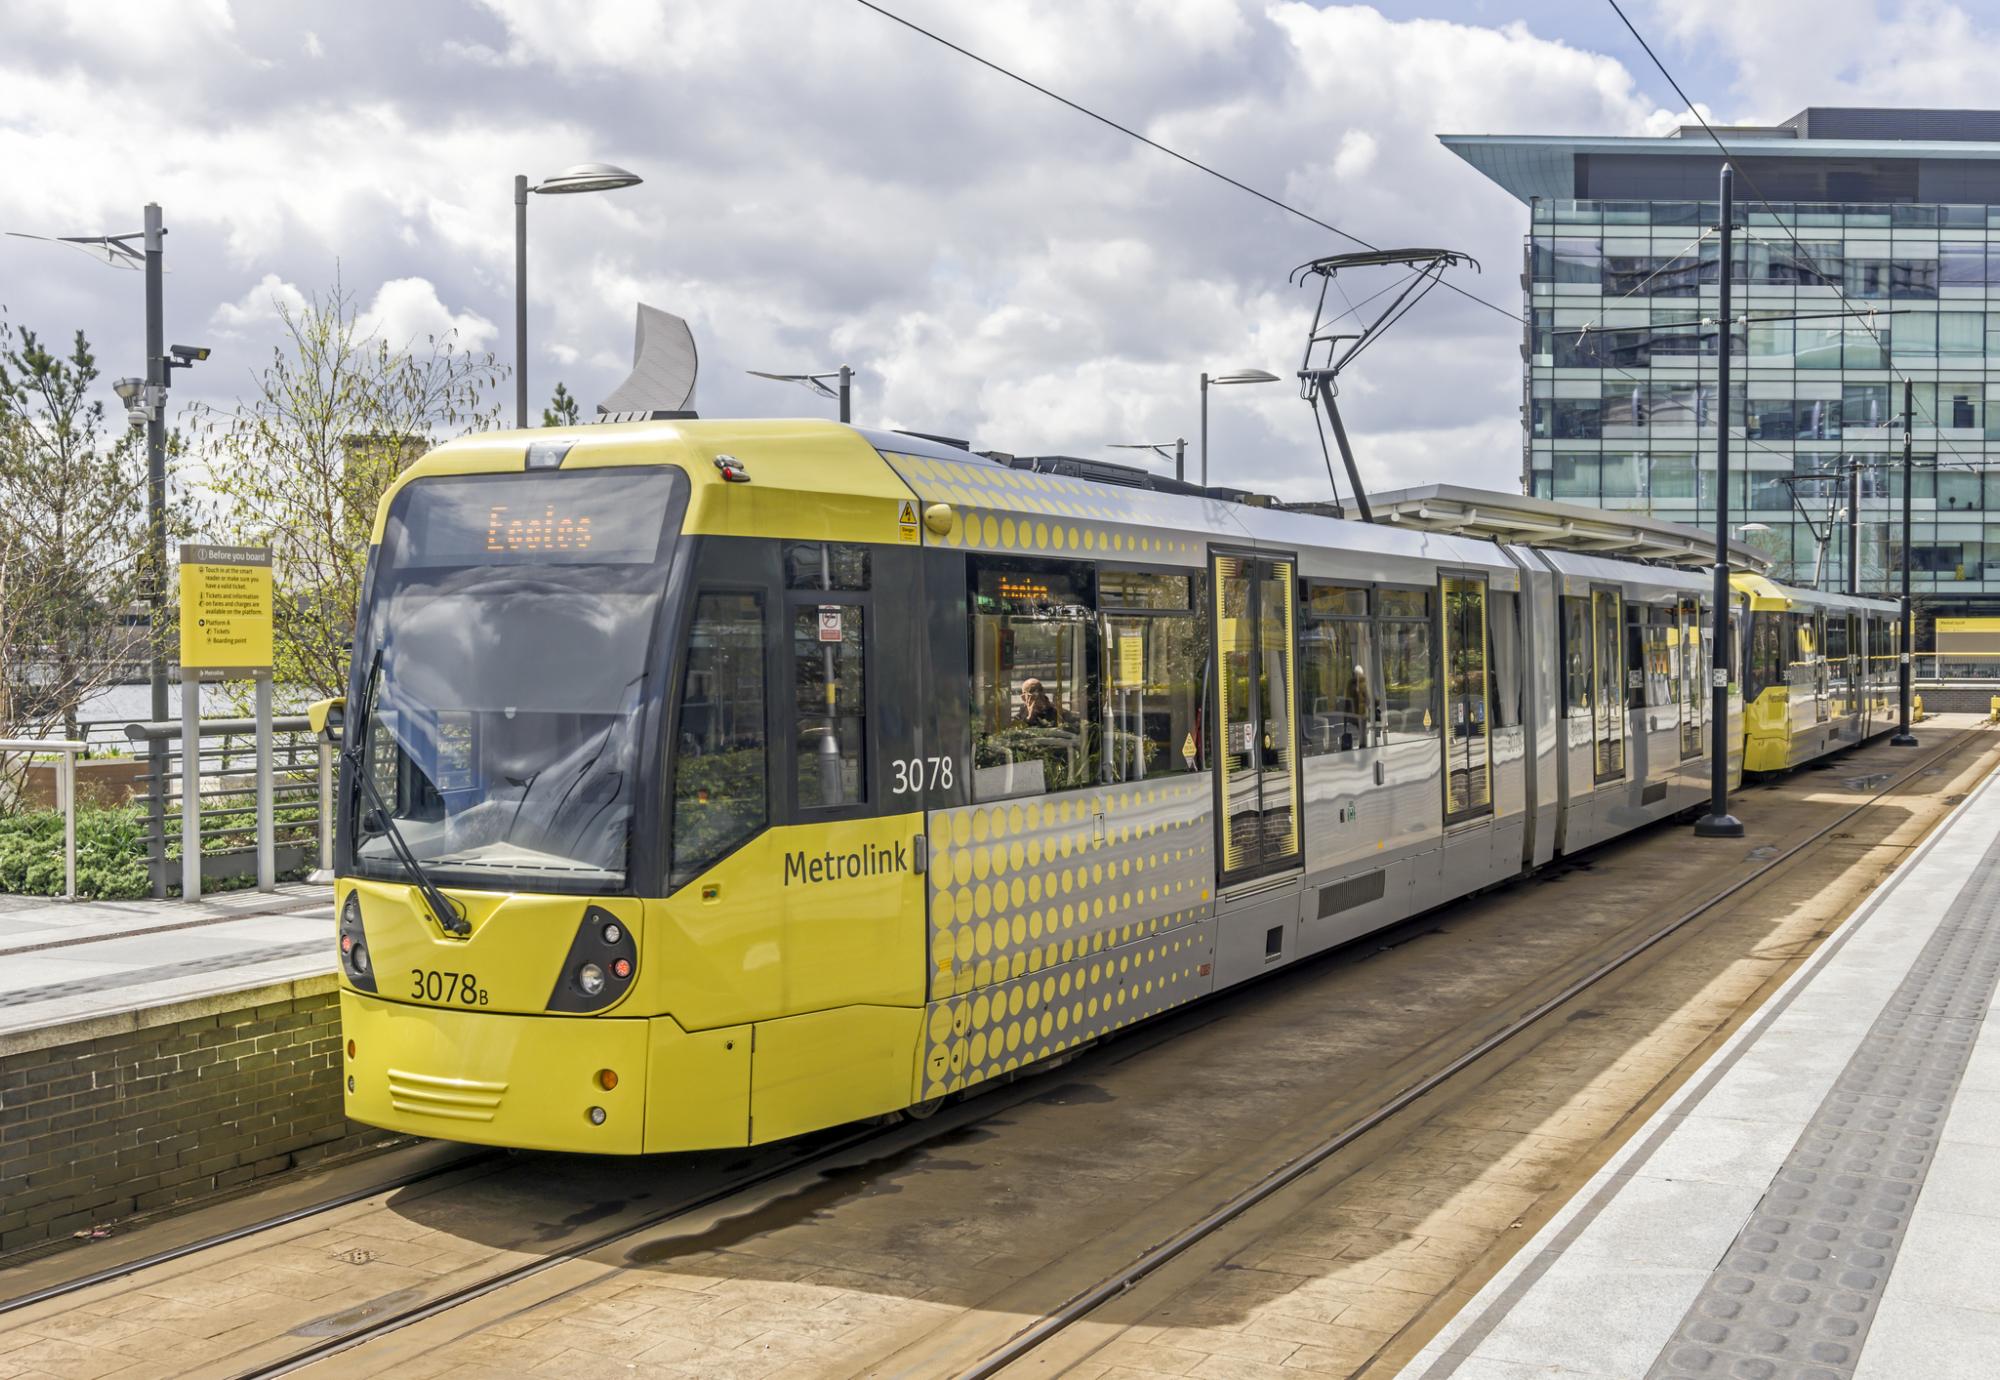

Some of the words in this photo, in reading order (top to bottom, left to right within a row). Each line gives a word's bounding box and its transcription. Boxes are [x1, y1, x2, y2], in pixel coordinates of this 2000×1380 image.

[208, 550, 232, 560] Before
[232, 553, 245, 562] you
[246, 552, 265, 562] board
[892, 756, 954, 794] 3078
[784, 840, 908, 886] Metrolink
